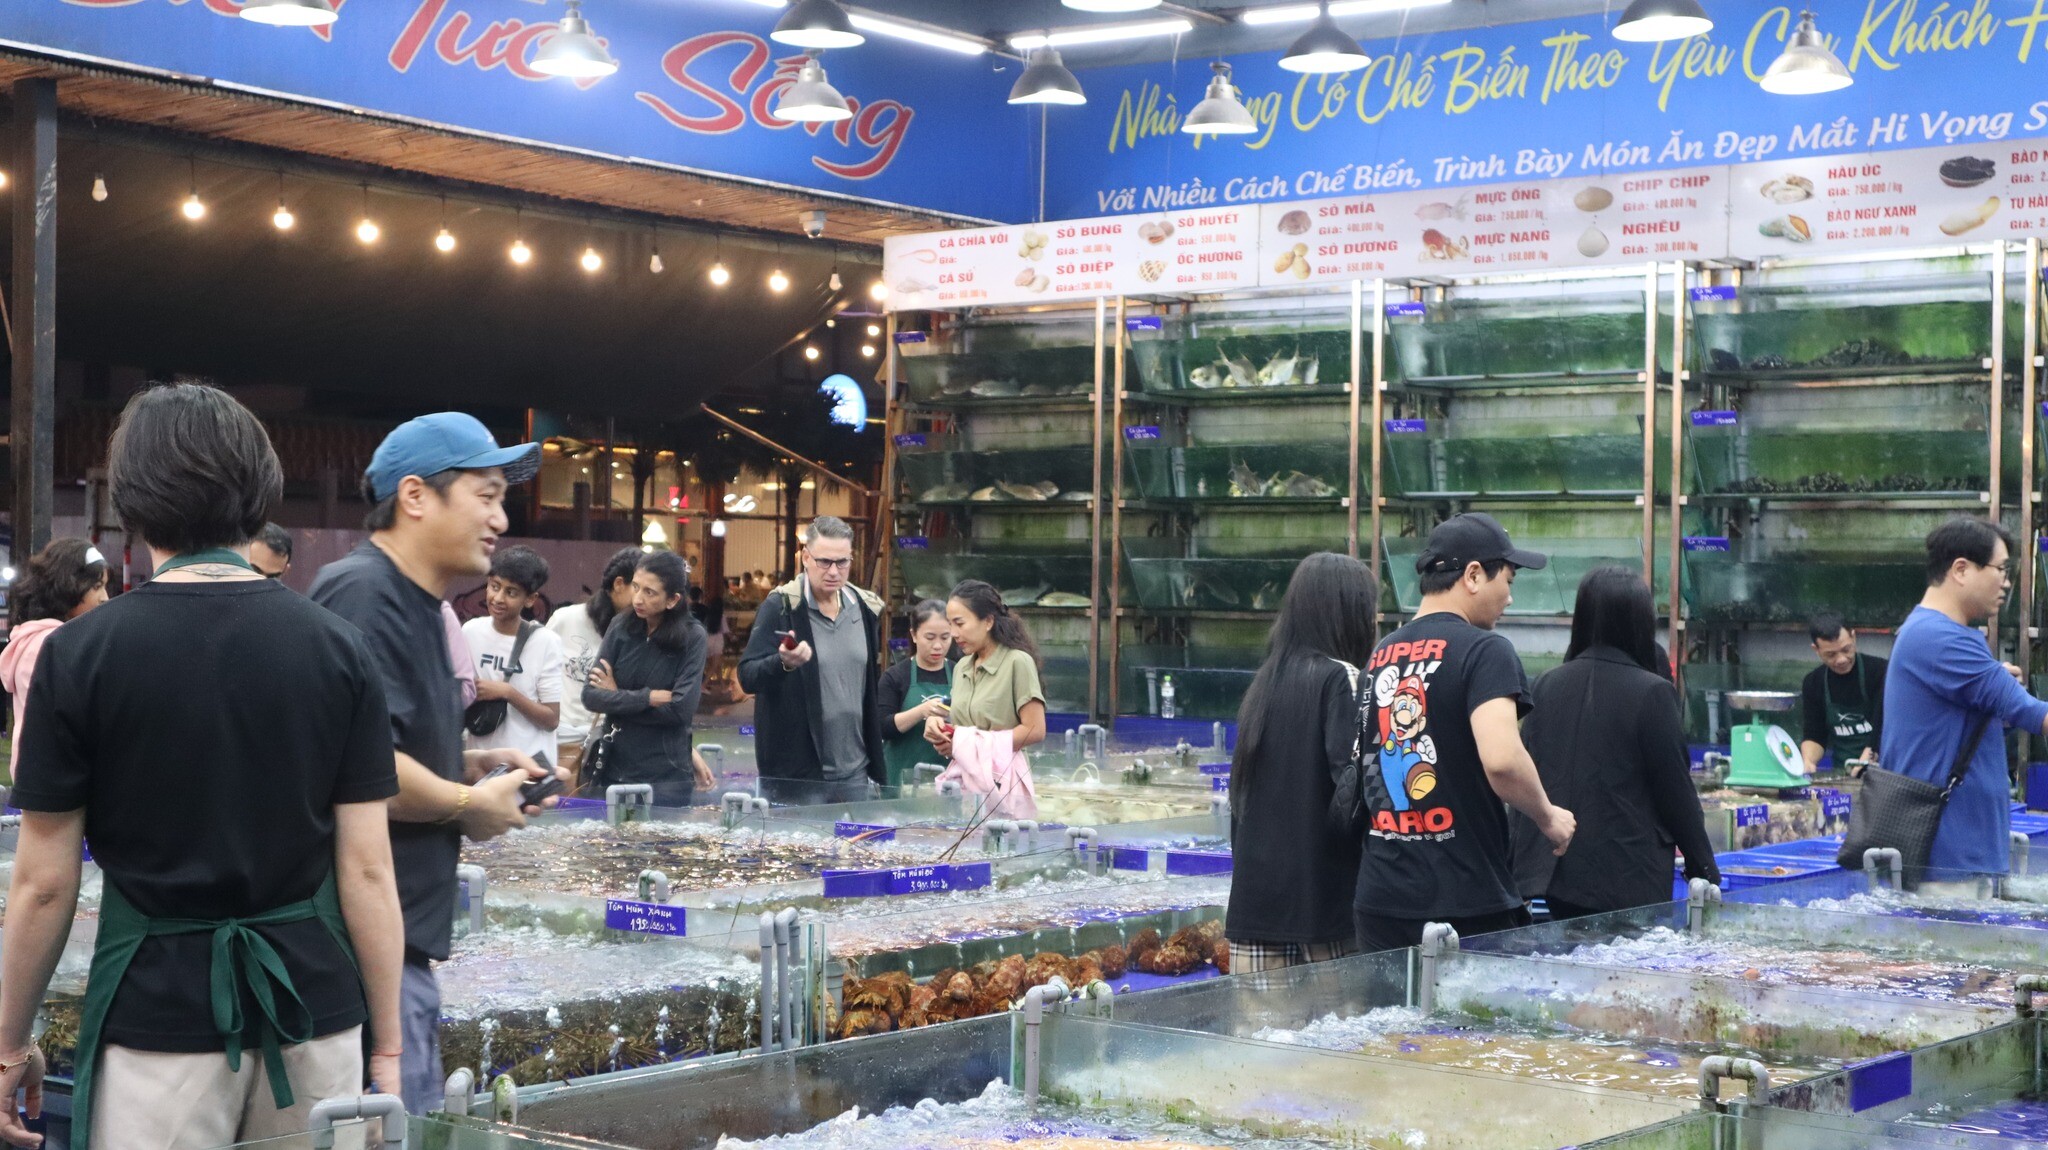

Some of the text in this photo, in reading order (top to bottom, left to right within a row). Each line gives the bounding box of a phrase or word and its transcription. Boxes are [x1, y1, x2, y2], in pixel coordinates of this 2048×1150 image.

[1109, 79, 1182, 153] Nhà
[1291, 71, 1350, 132] Có
[1356, 51, 1437, 124] Chế
[1440, 41, 1530, 116] Biến
[1541, 29, 1629, 105] Theo
[1647, 33, 1736, 112] Yêu
[1848, 0, 2000, 73] Khách
[1097, 187, 1137, 212] Với
[1142, 177, 1216, 208] Nhiều
[1224, 175, 1289, 201] Cách
[1295, 164, 1353, 196] Chế
[1353, 158, 1422, 190] Biến,
[1434, 154, 1507, 183] Trình
[1514, 148, 1574, 177] Bày
[1580, 140, 1651, 170] Món
[1657, 129, 1705, 163] Ăn
[1714, 130, 1778, 162] Đẹp
[1787, 115, 1859, 152] Mắt
[1867, 112, 1909, 146] Hi
[1920, 110, 2014, 144] Vọng
[2011, 148, 2038, 164] BÀO
[1828, 165, 1857, 179] HÀU
[1623, 175, 1710, 192] CHIP CHIP
[1475, 191, 1506, 205] MỰC
[1319, 203, 1339, 217] SÒ
[1827, 208, 1851, 222] BÀO
[1884, 204, 1917, 218] XANH
[1081, 224, 1122, 237] BUNG
[1622, 219, 1680, 236] NGHÊU
[1474, 230, 1550, 246] MỰC NANG
[1318, 240, 1398, 256] SÒ DƯƠNG
[1080, 260, 1114, 274] ĐIỆP
[1369, 639, 1447, 670] SUPER
[1371, 807, 1453, 834] ARIO
[607, 901, 623, 911] TÔM
[648, 907, 672, 918] XANH
